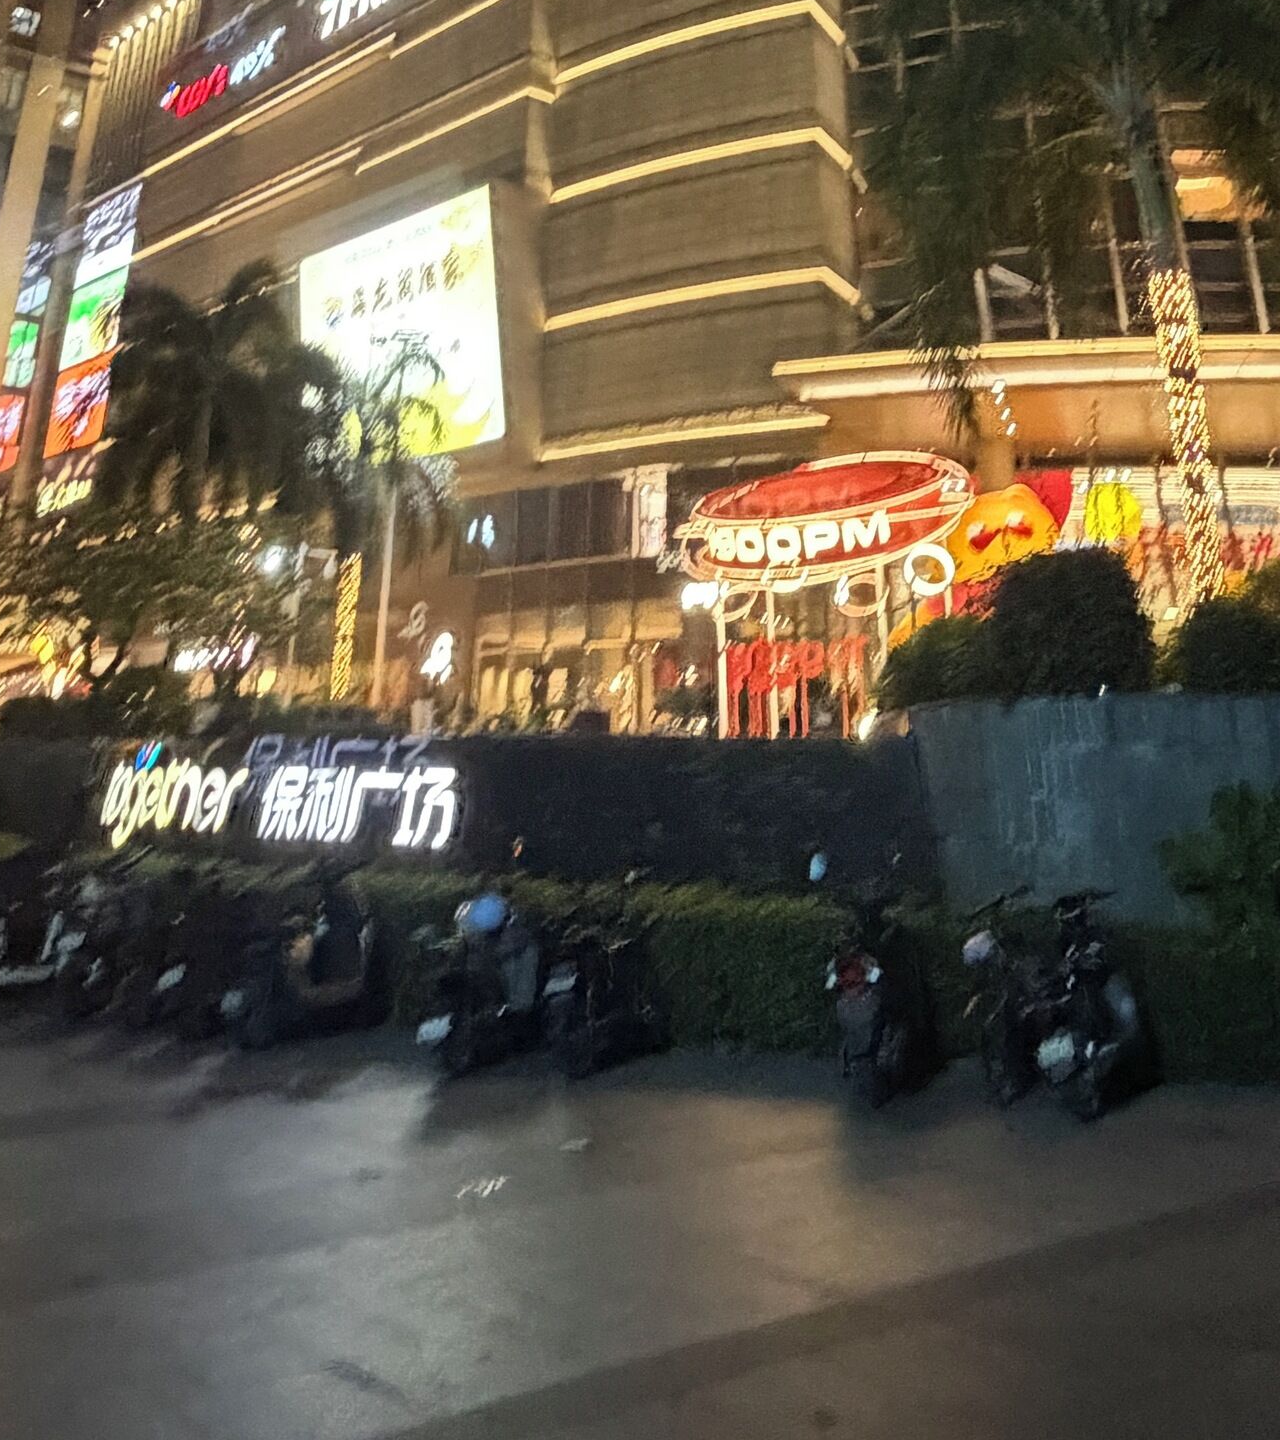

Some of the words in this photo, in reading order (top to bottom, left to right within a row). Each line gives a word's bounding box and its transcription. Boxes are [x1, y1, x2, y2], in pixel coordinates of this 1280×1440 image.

[100, 756, 249, 849] together
[257, 765, 456, 849] 保利广场
